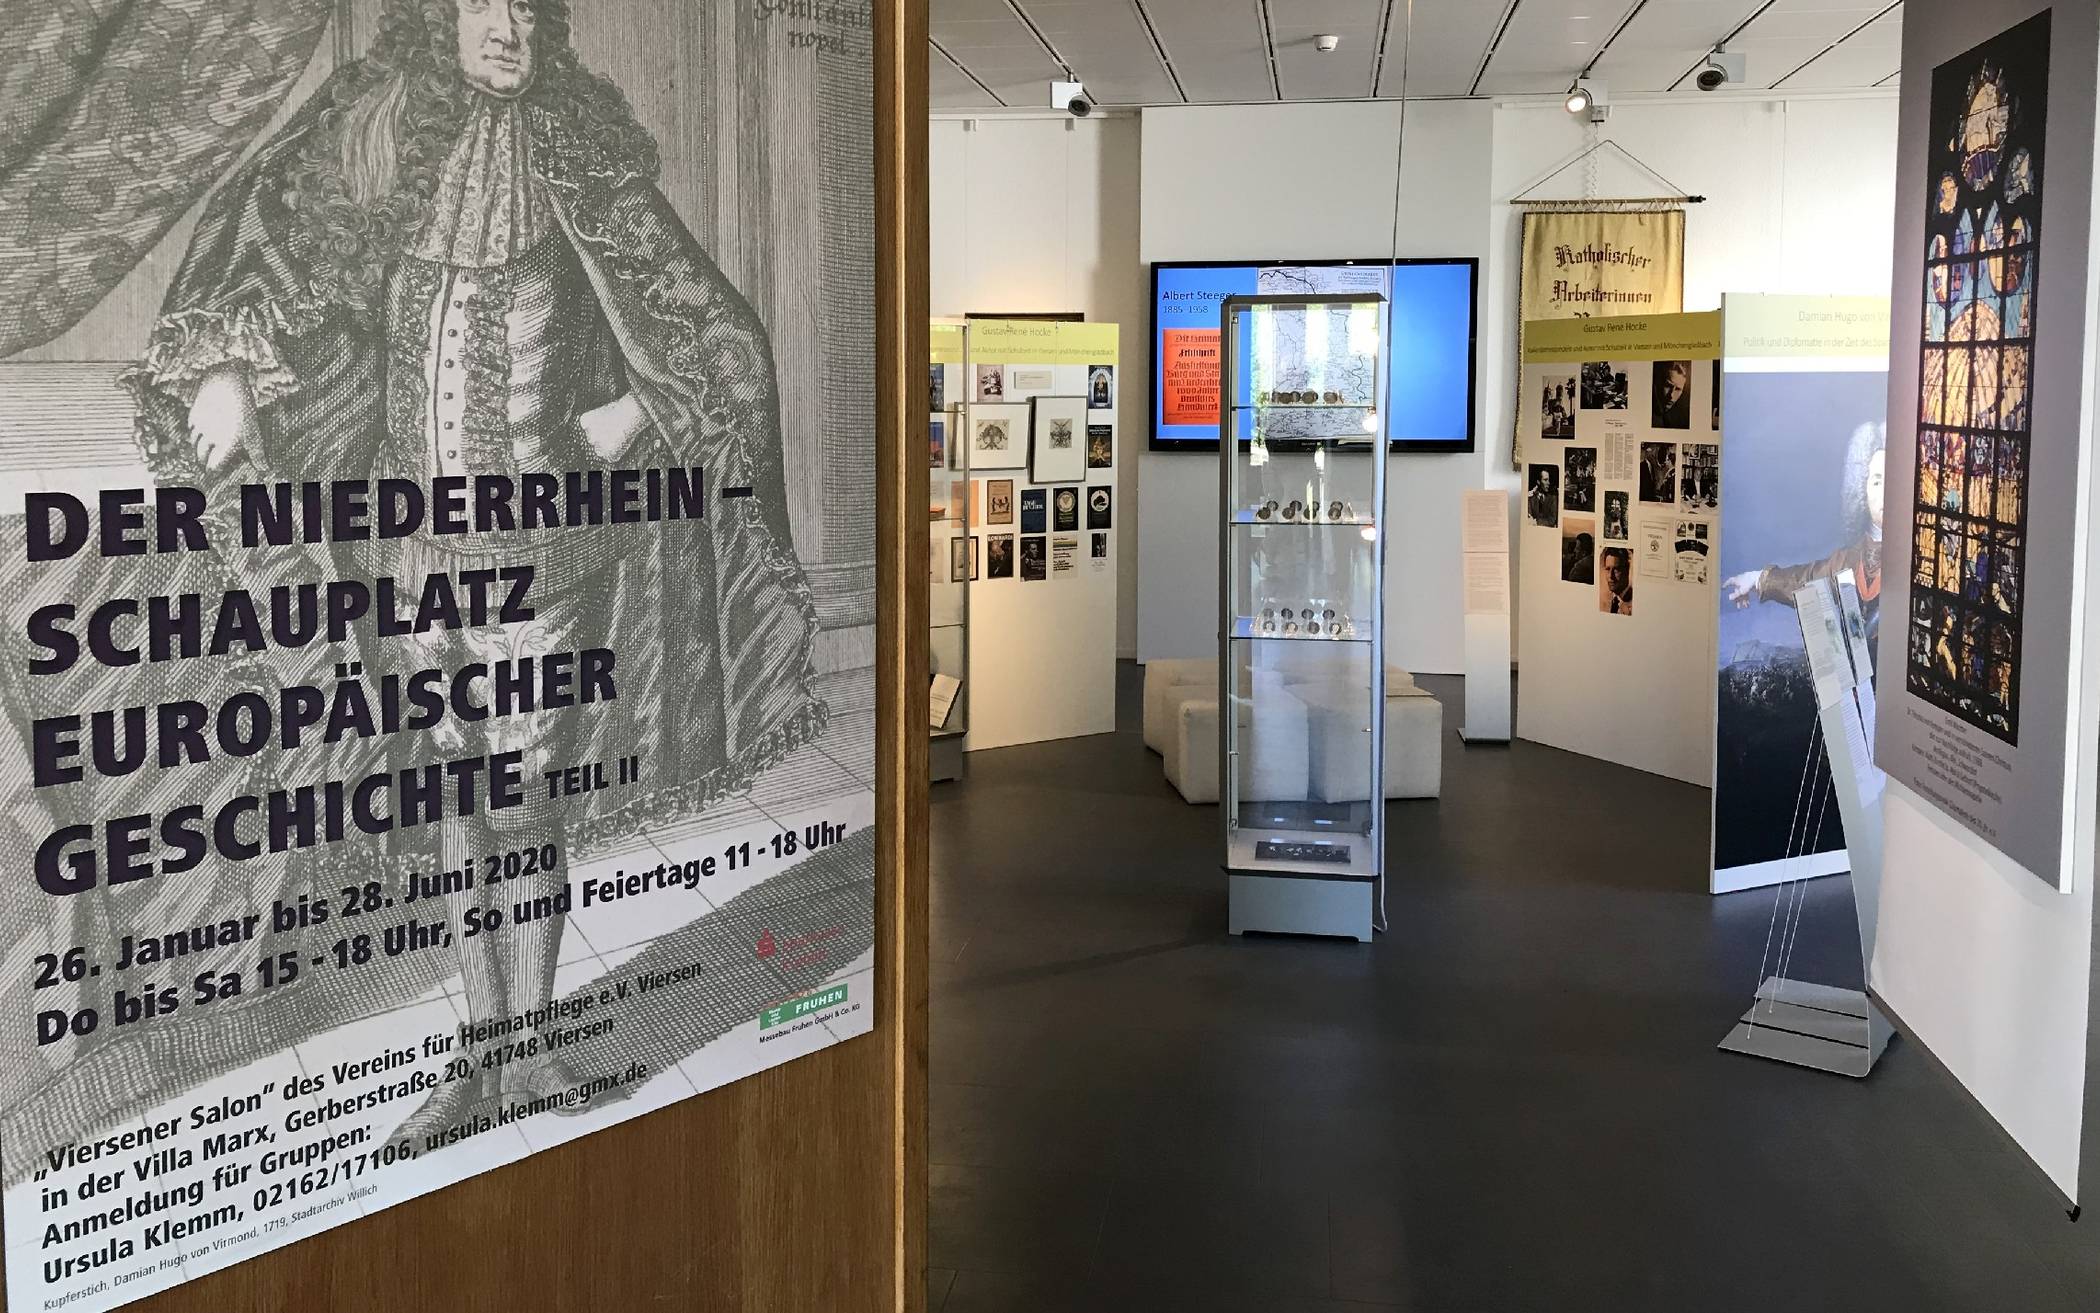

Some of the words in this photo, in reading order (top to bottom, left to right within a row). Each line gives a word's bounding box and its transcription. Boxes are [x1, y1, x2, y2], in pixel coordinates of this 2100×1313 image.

[1163, 291, 1194, 301] Albert
[1549, 280, 1652, 309] Arbeiterinnen
[1554, 243, 1652, 271] Katholischer
[1625, 321, 1648, 332] Hocke
[1798, 310, 1833, 322] Damian
[1834, 311, 1857, 324] Hugo
[25, 485, 208, 562] DER
[240, 467, 705, 548] NIEDERRHEIN
[26, 566, 536, 677] SCHAUPLATZ
[32, 648, 618, 788] EUROPÄISCHER
[34, 751, 522, 896] GESCHICHTE
[544, 761, 609, 799] TEIL
[619, 755, 638, 785] II
[34, 947, 101, 989] 26.
[115, 914, 261, 970] Januar
[273, 896, 328, 933] bis
[341, 881, 394, 918] 28.
[404, 859, 474, 904] Juni
[485, 844, 557, 885] 2020
[37, 1008, 99, 1047] Do
[115, 983, 179, 1026] bis
[194, 970, 241, 1006] Sa
[256, 951, 299, 988] 15
[331, 934, 371, 969] 18
[384, 920, 452, 957] Uhr,
[463, 907, 501, 937] So
[514, 884, 571, 925] und
[583, 856, 716, 908] Feiertage
[725, 841, 750, 870] 11
[771, 830, 797, 858] 18
[806, 821, 846, 850] Uhr
[759, 1029, 791, 1043] Messebau
[792, 1020, 814, 1032] Fruhen
[815, 1012, 834, 1025] GmbH
[834, 1010, 840, 1018] &
[840, 1007, 850, 1015] Co.
[851, 1003, 861, 1012] KG
[795, 990, 843, 1014] FRUHEN
[34, 1116, 182, 1183] „Viersener
[283, 1075, 325, 1101] des
[332, 1046, 416, 1085] Vereins
[422, 1034, 455, 1058] für
[461, 994, 594, 1048] Heimatpflege
[601, 980, 632, 1004] e.V.
[638, 963, 701, 994] Viersen
[41, 1187, 68, 1212] in
[78, 1171, 125, 1200] der
[133, 1148, 193, 1182] Villa
[203, 1125, 276, 1160] Marx,
[285, 1071, 438, 1133] Gerberstraße
[444, 1058, 475, 1084] 20,
[481, 1037, 538, 1069] 41748
[544, 1018, 614, 1051] Viersen
[41, 1180, 204, 1249] Anmeldung
[212, 1162, 252, 1192] für
[259, 1124, 371, 1175] Gruppen:
[44, 1237, 134, 1284] Ursula
[144, 1203, 244, 1250] Klemm,
[253, 1139, 417, 1212] 02162/17106,
[425, 1061, 648, 1151] ursula.klemm@gmx.de
[44, 1279, 110, 1311] Kupferstich,
[114, 1265, 156, 1286] Damian
[160, 1252, 188, 1273] Hugo
[190, 1246, 210, 1259] von
[212, 1228, 260, 1251] Virmond,
[263, 1216, 288, 1233] 1719,
[291, 1197, 346, 1224] Stadtarchiv
[347, 1184, 378, 1201] Willich
